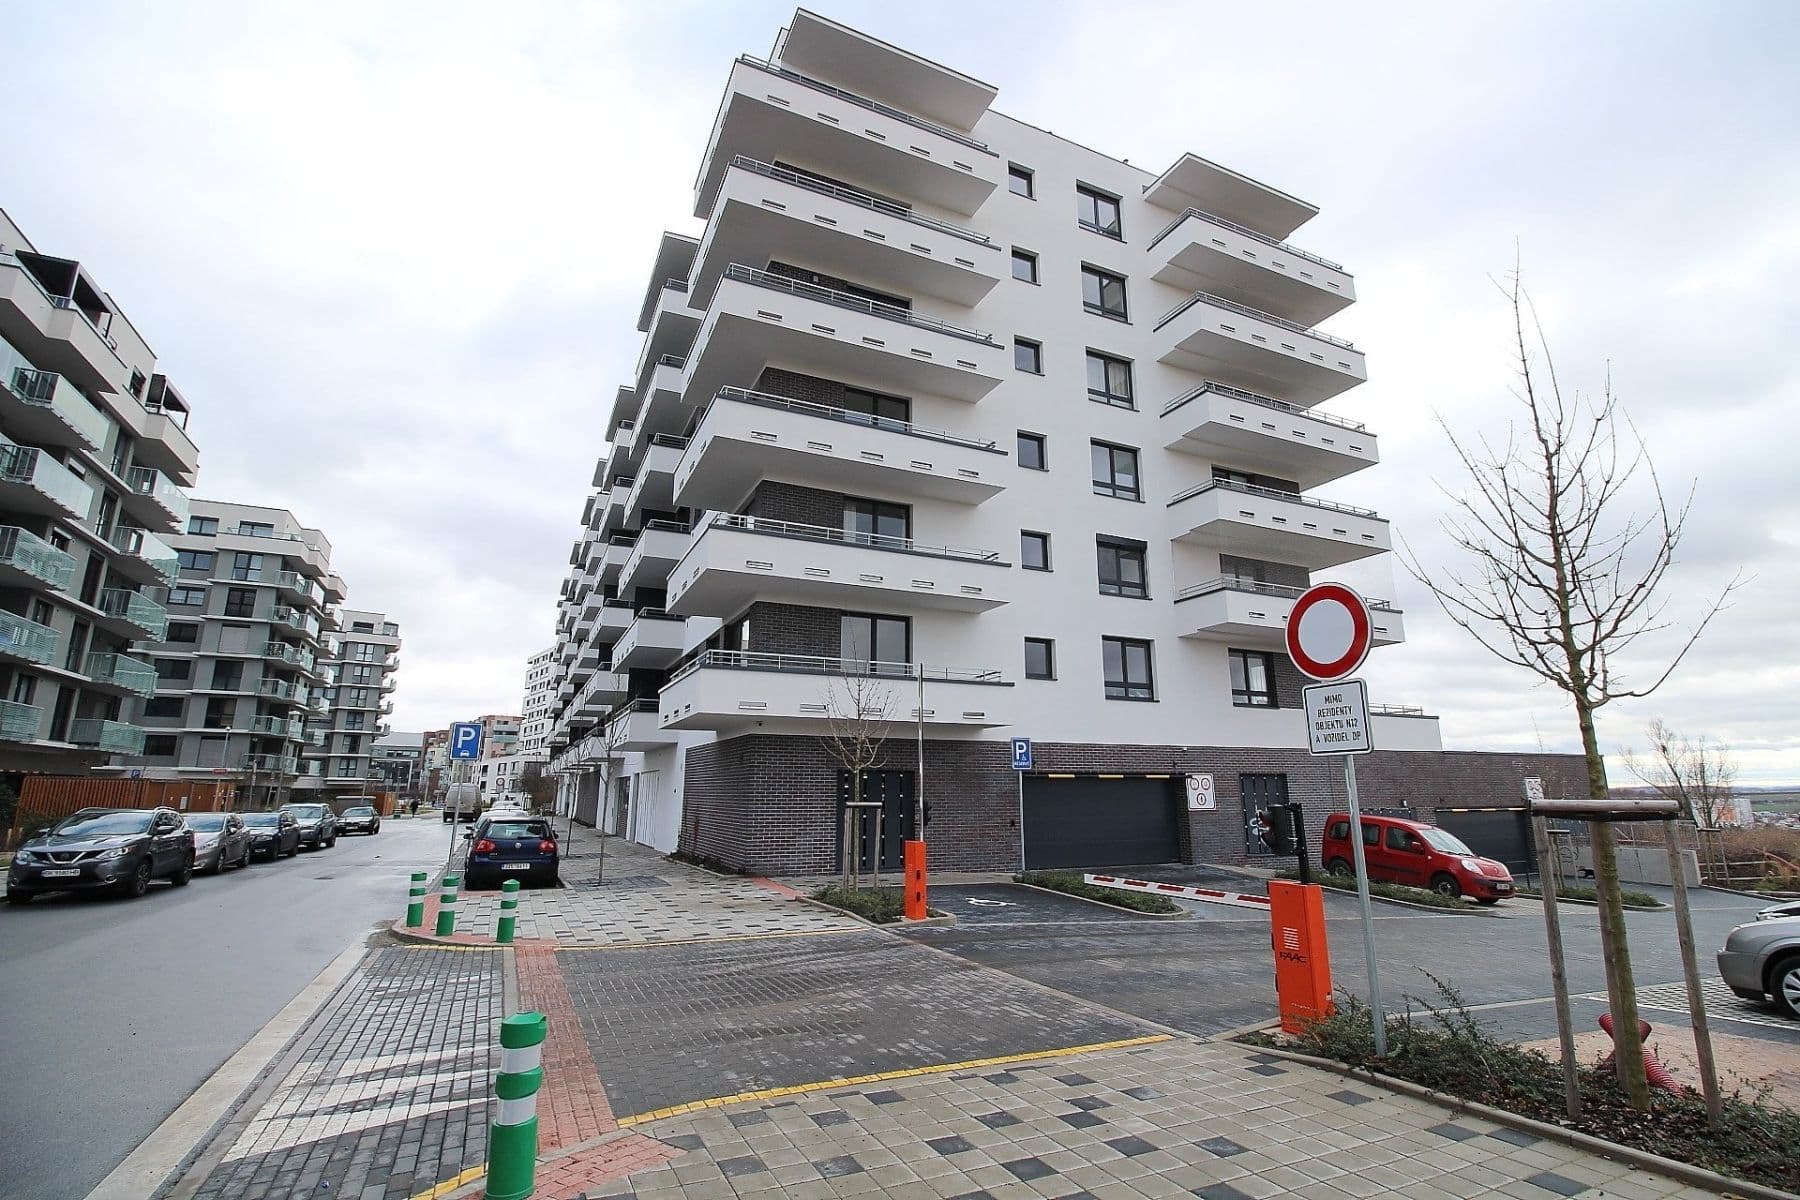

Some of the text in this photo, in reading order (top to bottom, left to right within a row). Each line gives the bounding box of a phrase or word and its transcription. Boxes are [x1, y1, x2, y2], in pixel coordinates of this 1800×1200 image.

[1324, 693, 1343, 704] MIMO
[1317, 705, 1352, 718] REZIDENTY
[1315, 719, 1344, 731] OBJEKTU
[457, 727, 476, 749] P
[1315, 734, 1321, 743] A
[1322, 731, 1350, 743] VOZIDEL
[1015, 741, 1027, 760] P
